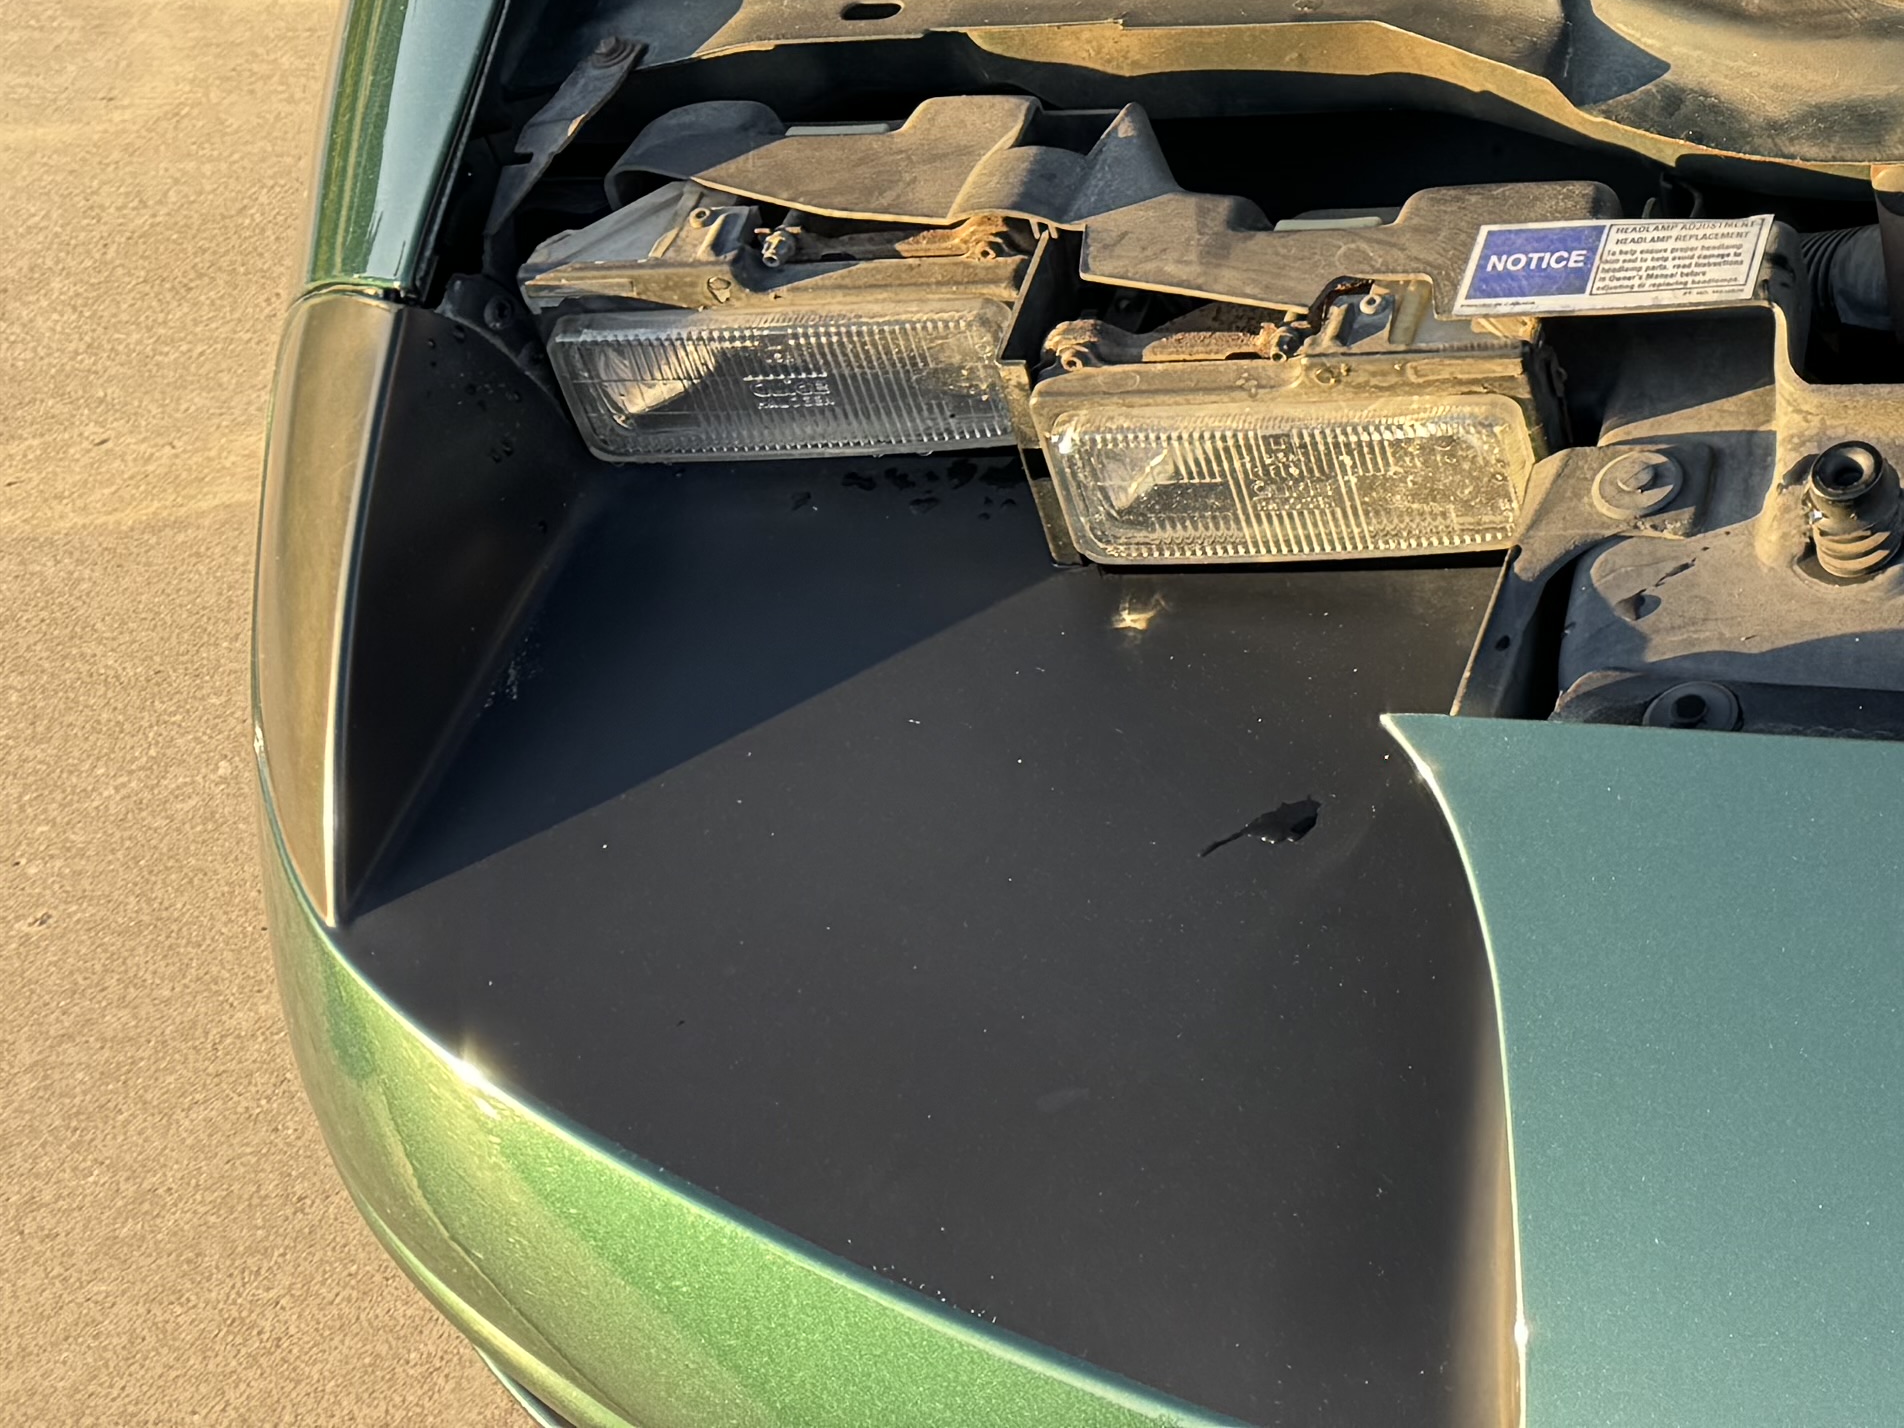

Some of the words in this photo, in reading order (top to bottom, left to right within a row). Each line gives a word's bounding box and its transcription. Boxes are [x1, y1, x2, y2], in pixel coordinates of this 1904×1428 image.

[1615, 223, 1679, 235] HEADLAMP
[1615, 234, 1673, 246] HEADLAMP
[1675, 231, 1749, 243] REPLACEMENT
[1487, 249, 1587, 273] NOTICE
